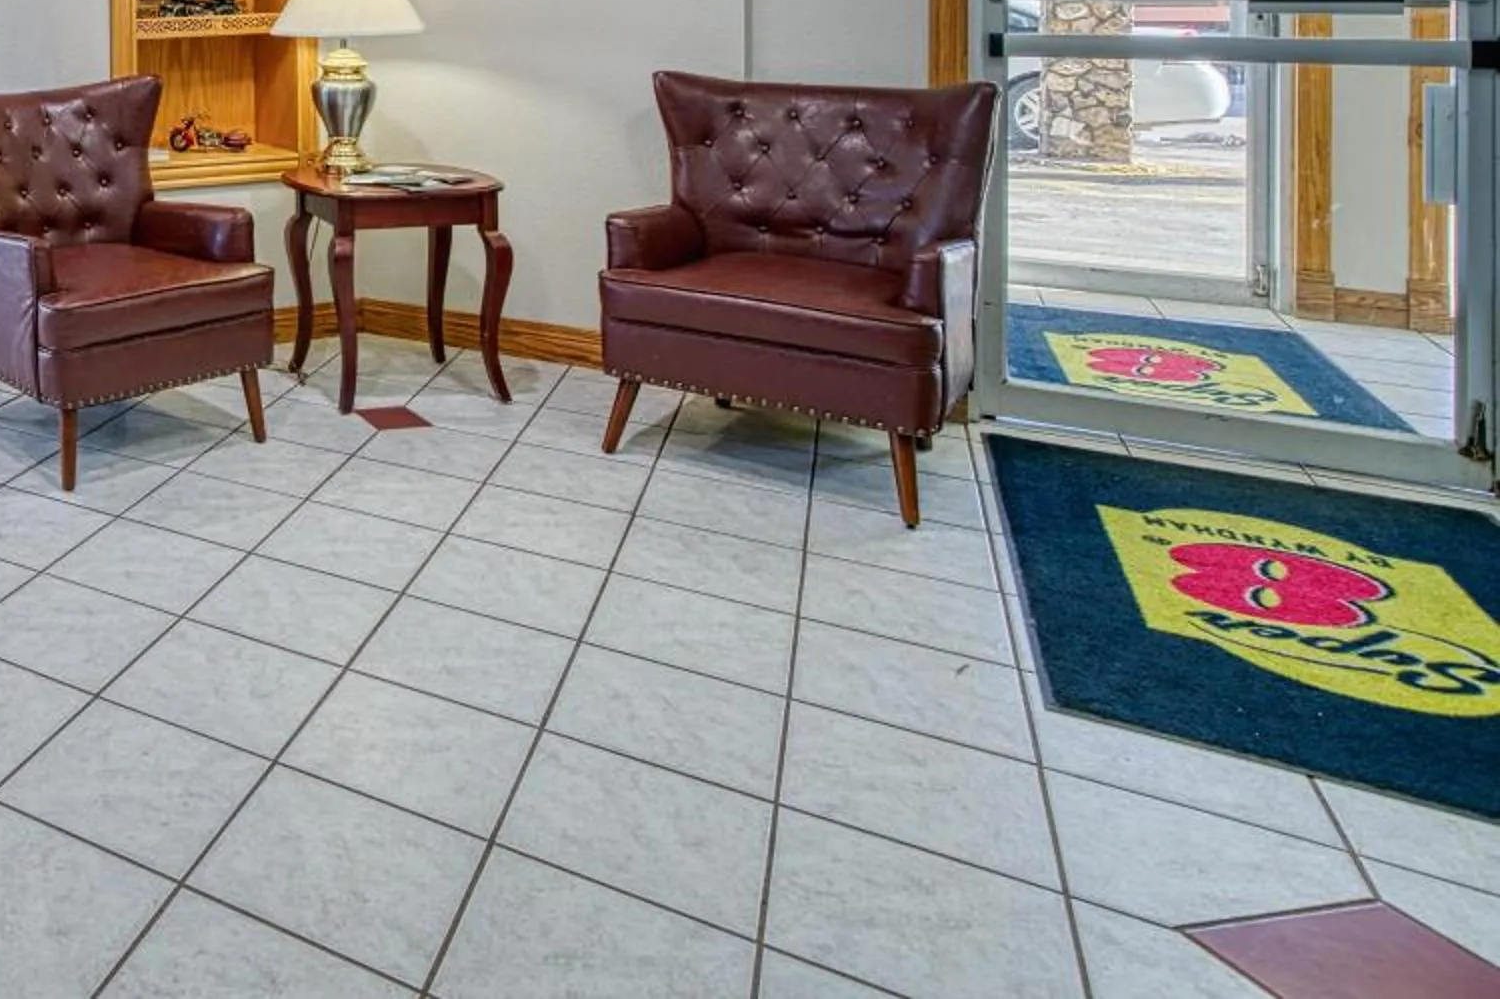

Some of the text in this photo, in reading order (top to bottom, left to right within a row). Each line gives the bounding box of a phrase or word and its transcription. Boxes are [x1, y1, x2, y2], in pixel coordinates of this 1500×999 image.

[1141, 514, 1396, 571] BY WYNDHAM
[1183, 610, 1500, 695] Super
